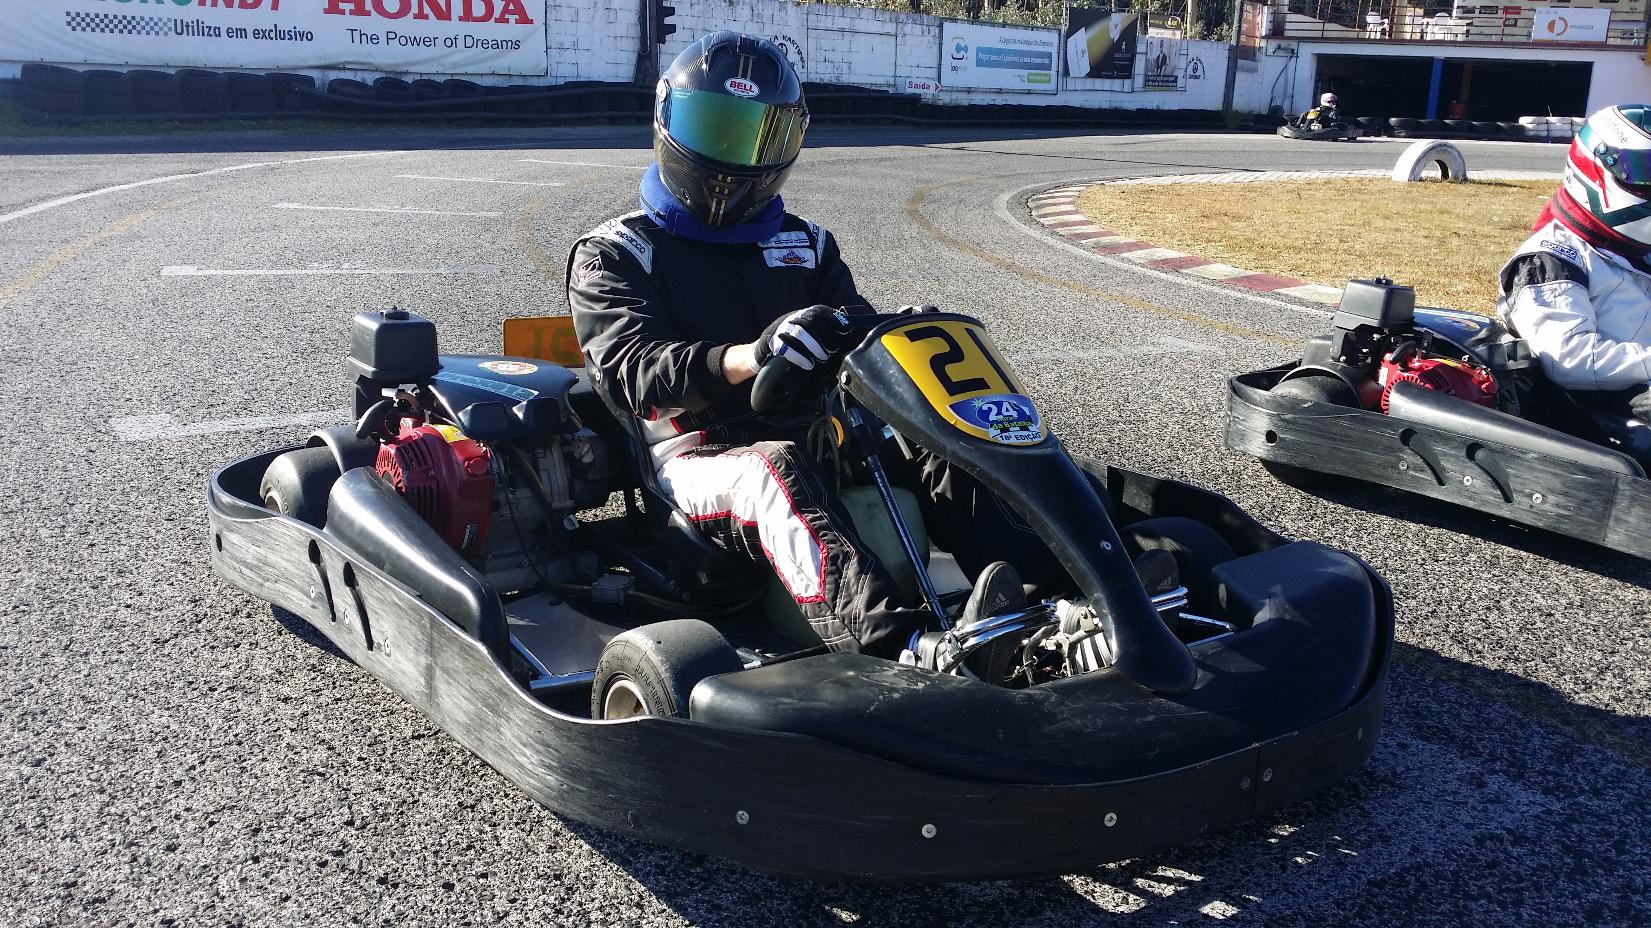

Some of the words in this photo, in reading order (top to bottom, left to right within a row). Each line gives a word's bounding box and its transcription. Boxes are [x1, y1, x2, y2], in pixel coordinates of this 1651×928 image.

[173, 18, 222, 38] Utiliza
[226, 26, 248, 40] em
[252, 24, 314, 42] exclusivo
[346, 28, 380, 45] The
[386, 31, 439, 48] Power
[443, 34, 459, 49] of
[463, 34, 521, 50] Dreams
[729, 80, 755, 93] BELL
[904, 325, 1020, 397] 21
